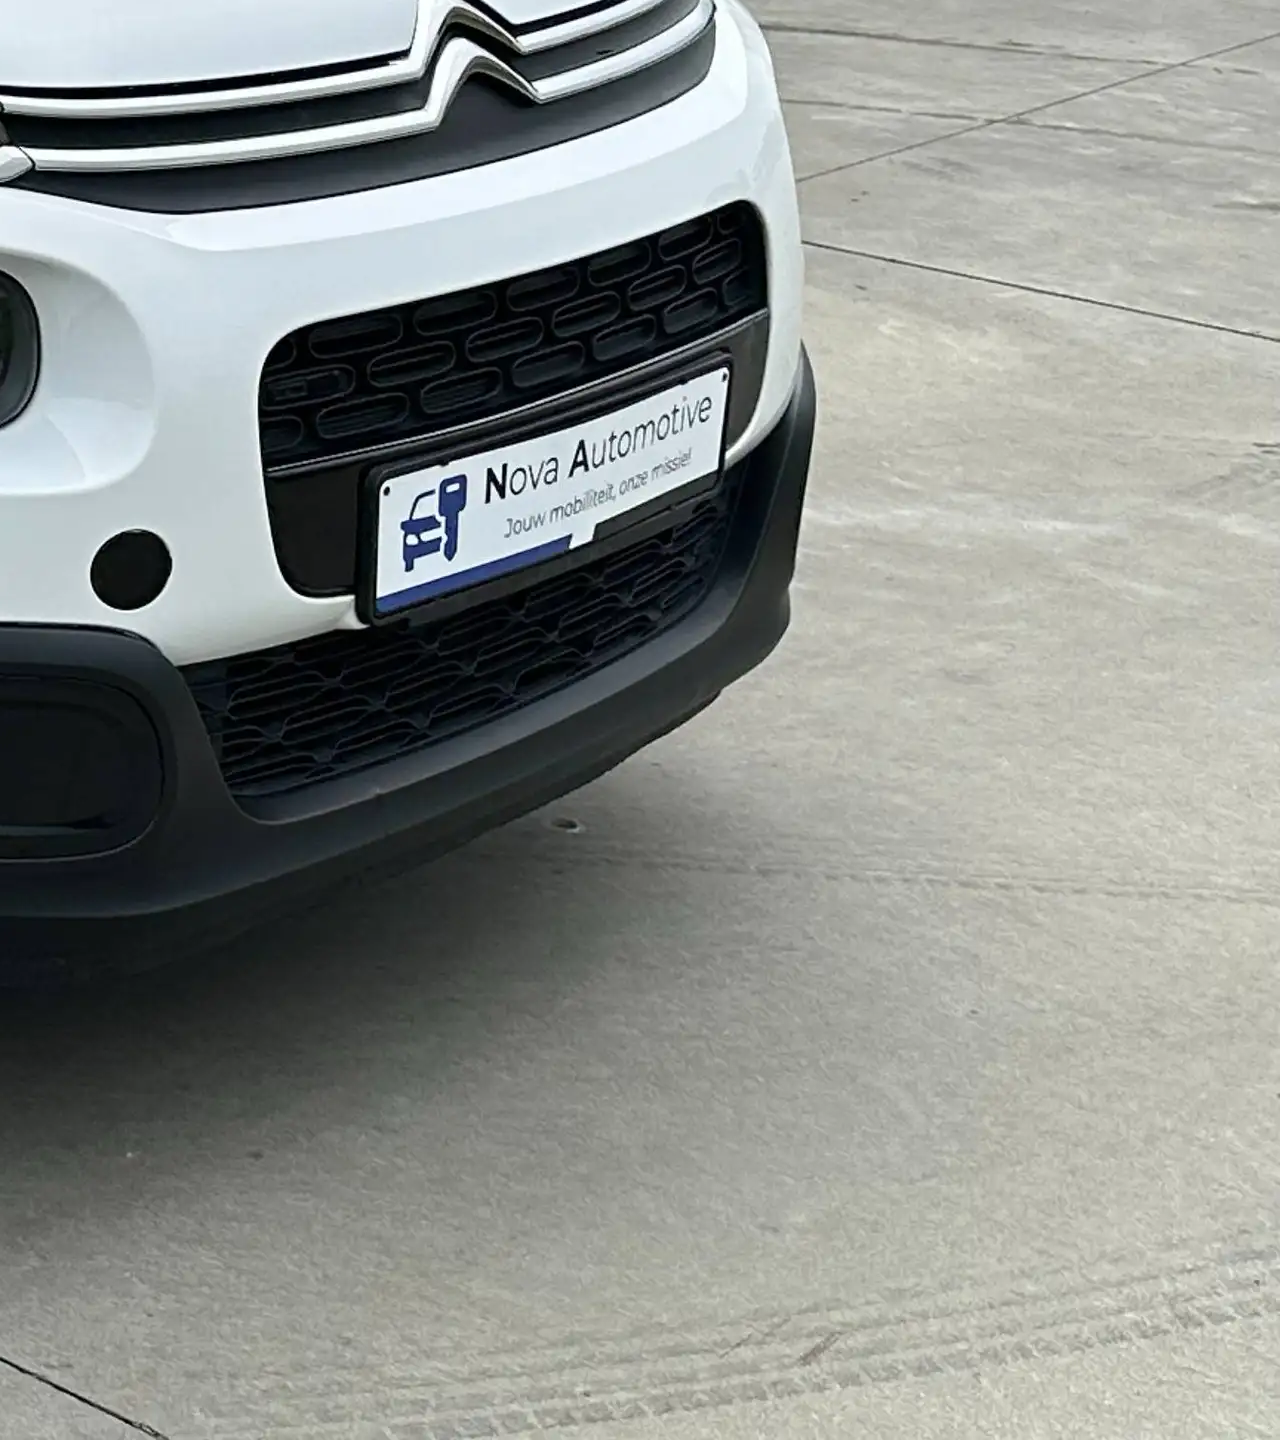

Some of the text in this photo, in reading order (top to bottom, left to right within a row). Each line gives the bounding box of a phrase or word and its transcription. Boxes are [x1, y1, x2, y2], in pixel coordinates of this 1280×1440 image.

[484, 396, 712, 504] Nova Automotive
[504, 512, 546, 538] Jouw
[619, 470, 649, 495] onze
[651, 448, 692, 481] missie!
